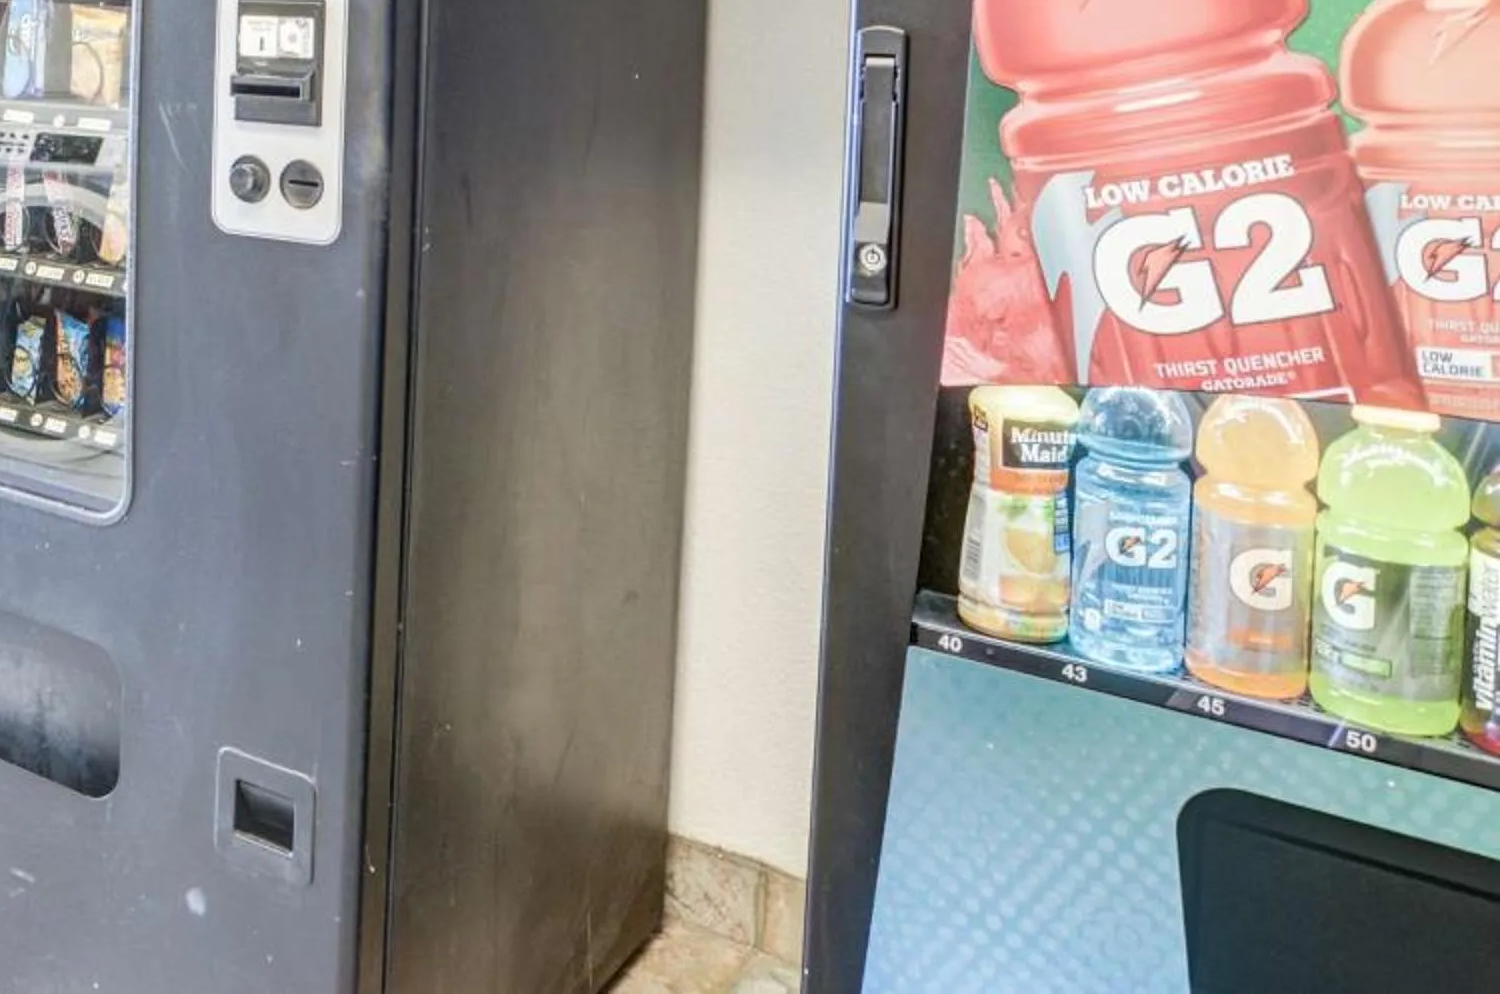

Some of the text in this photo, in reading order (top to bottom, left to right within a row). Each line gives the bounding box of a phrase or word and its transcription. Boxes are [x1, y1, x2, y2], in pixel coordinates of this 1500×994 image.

[1085, 154, 1296, 209] LOW CALORIE
[1401, 195, 1451, 210] LOW
[1092, 192, 1338, 336] G2
[1154, 346, 1326, 380] THIRST QUENCHER
[1421, 350, 1454, 363] LOW
[1422, 363, 1485, 379] CALORIE
[1021, 443, 1068, 464] Maid
[1105, 526, 1178, 569] G2
[1230, 547, 1293, 611] G
[1321, 560, 1381, 631] G
[937, 634, 963, 654] 40
[1061, 663, 1088, 684] 43
[1197, 696, 1226, 716] 45
[1346, 731, 1377, 752] 50
